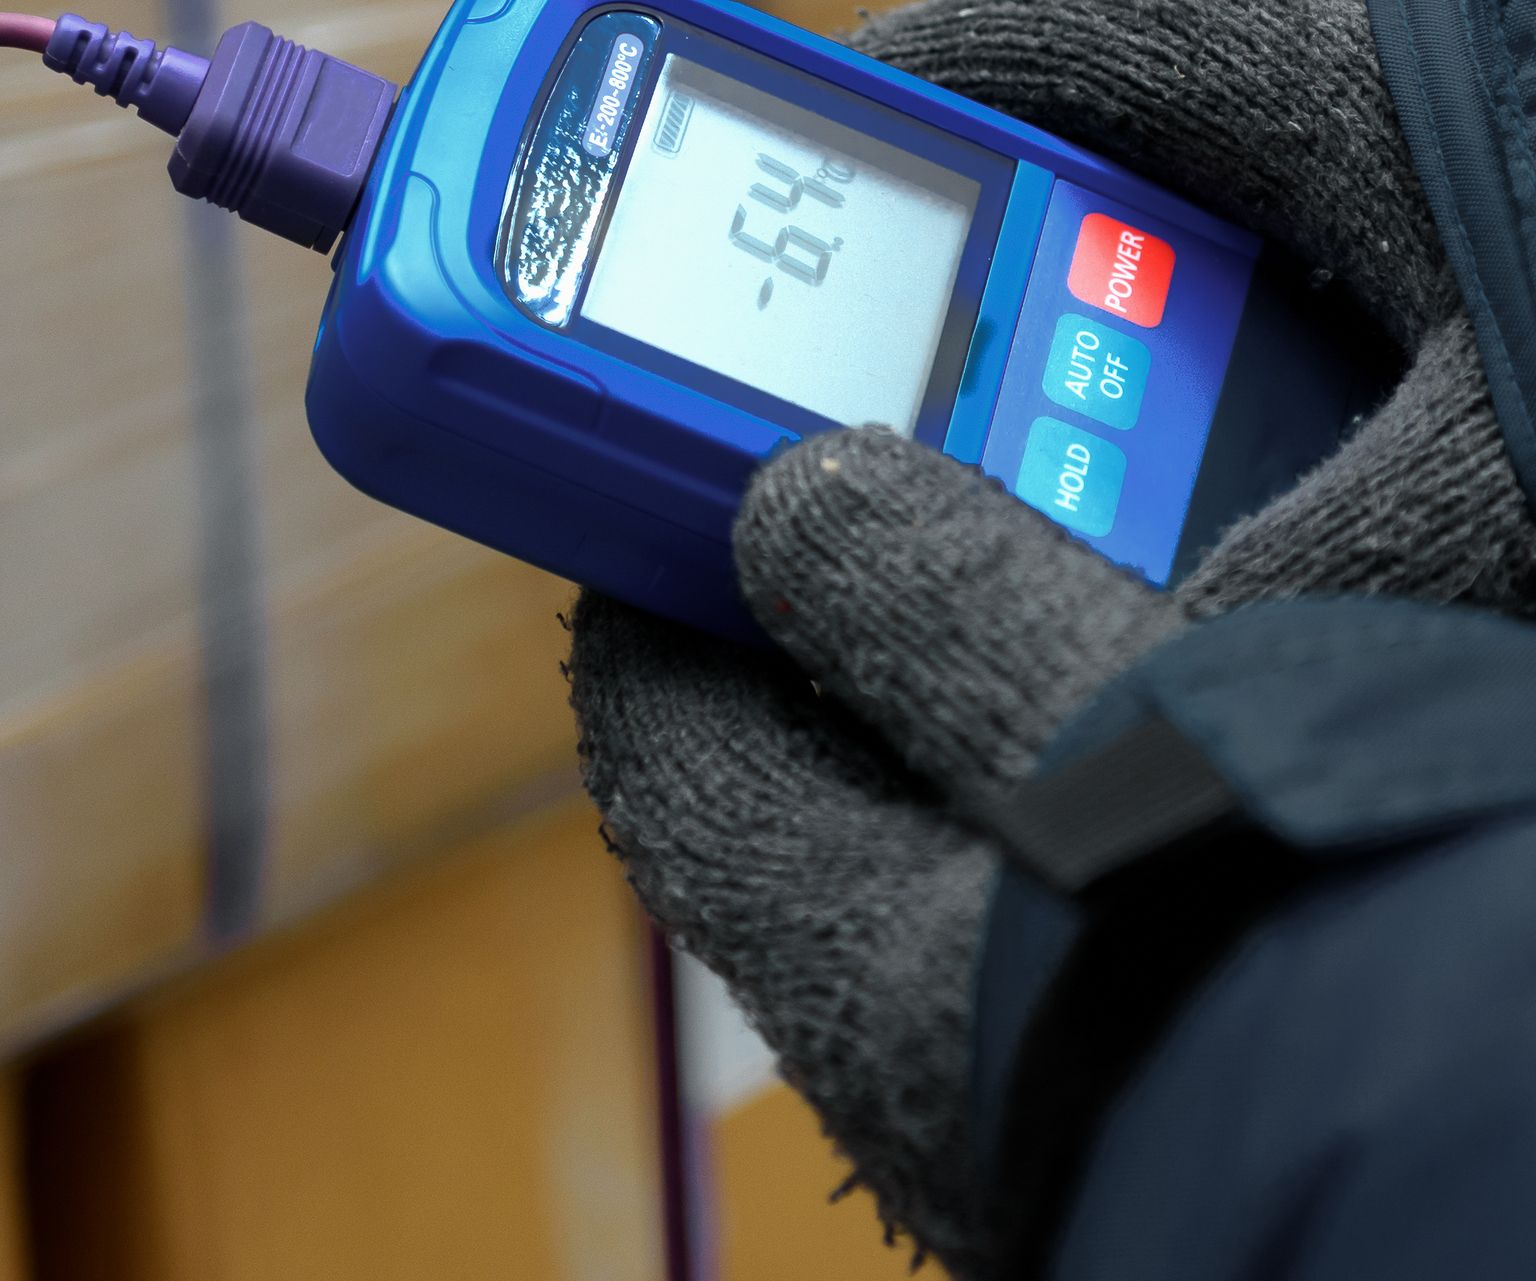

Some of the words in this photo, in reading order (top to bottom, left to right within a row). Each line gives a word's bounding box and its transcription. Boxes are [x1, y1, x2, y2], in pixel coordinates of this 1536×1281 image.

[1104, 229, 1145, 313] POWER
[1064, 330, 1100, 400] AUTO
[1099, 351, 1129, 399] OFF
[1054, 442, 1092, 512] HOLD
